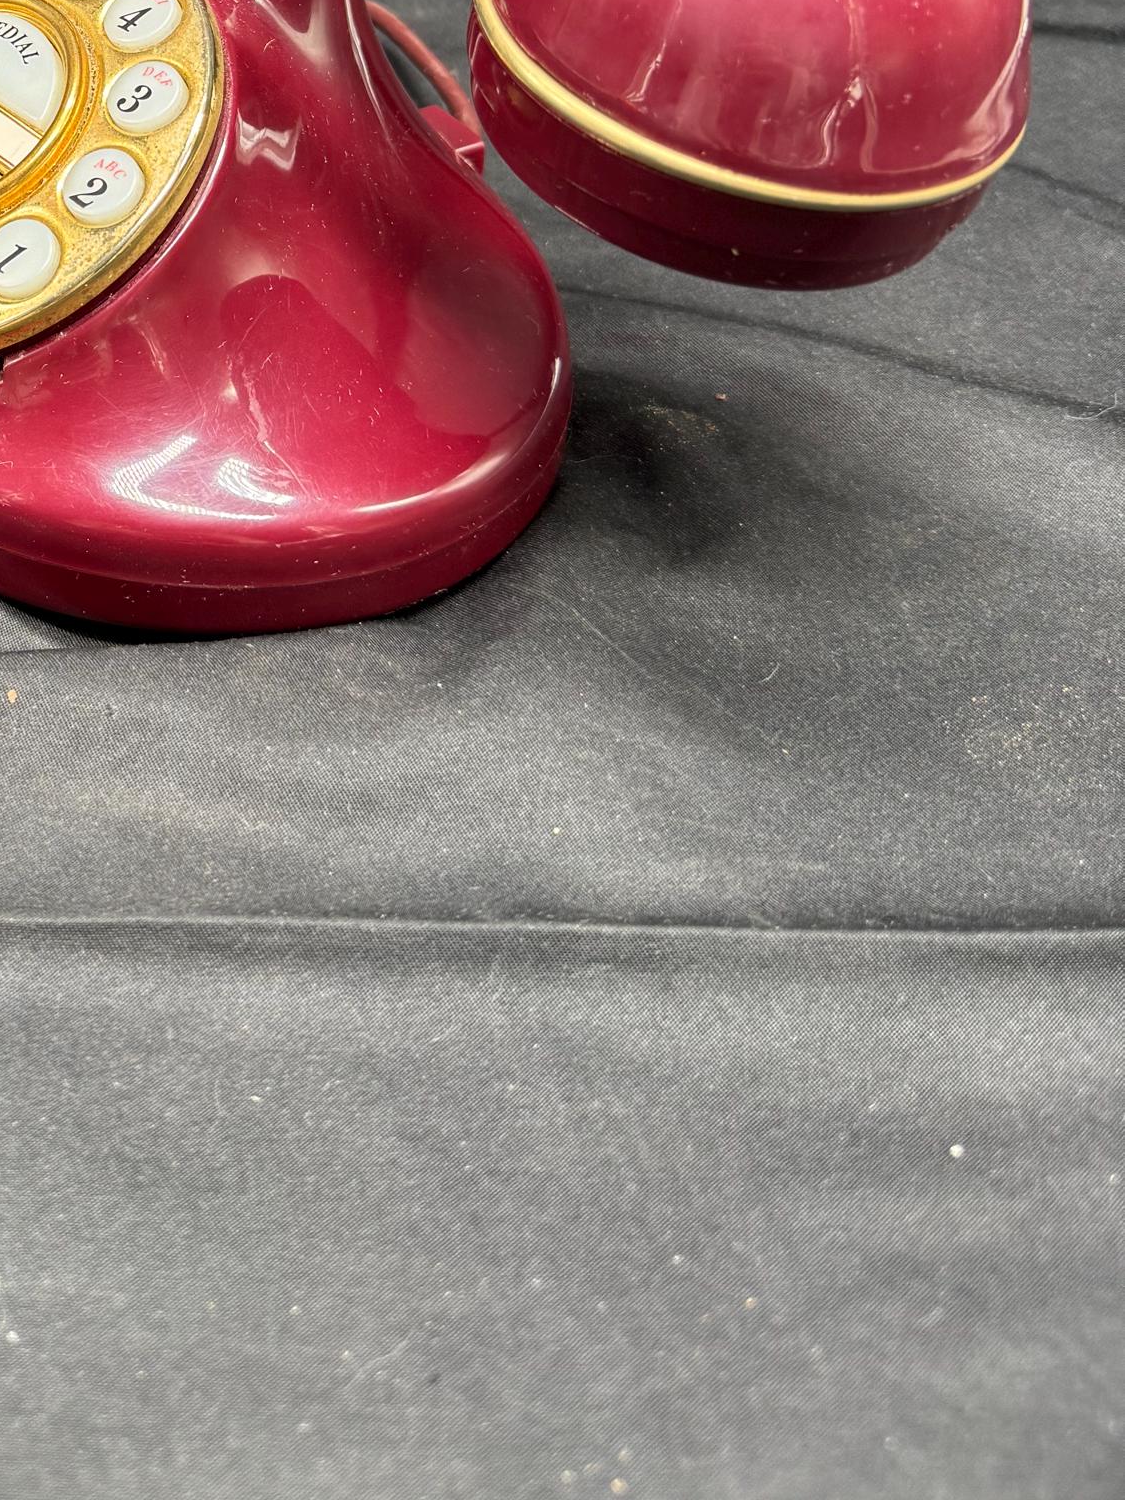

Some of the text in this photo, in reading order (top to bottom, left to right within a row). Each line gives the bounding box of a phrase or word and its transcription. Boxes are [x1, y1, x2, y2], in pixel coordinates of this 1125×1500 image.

[118, 8, 152, 32] 4
[142, 66, 173, 87] DEF
[117, 85, 152, 112] 3
[94, 158, 127, 177] ABC
[69, 178, 107, 208] 2
